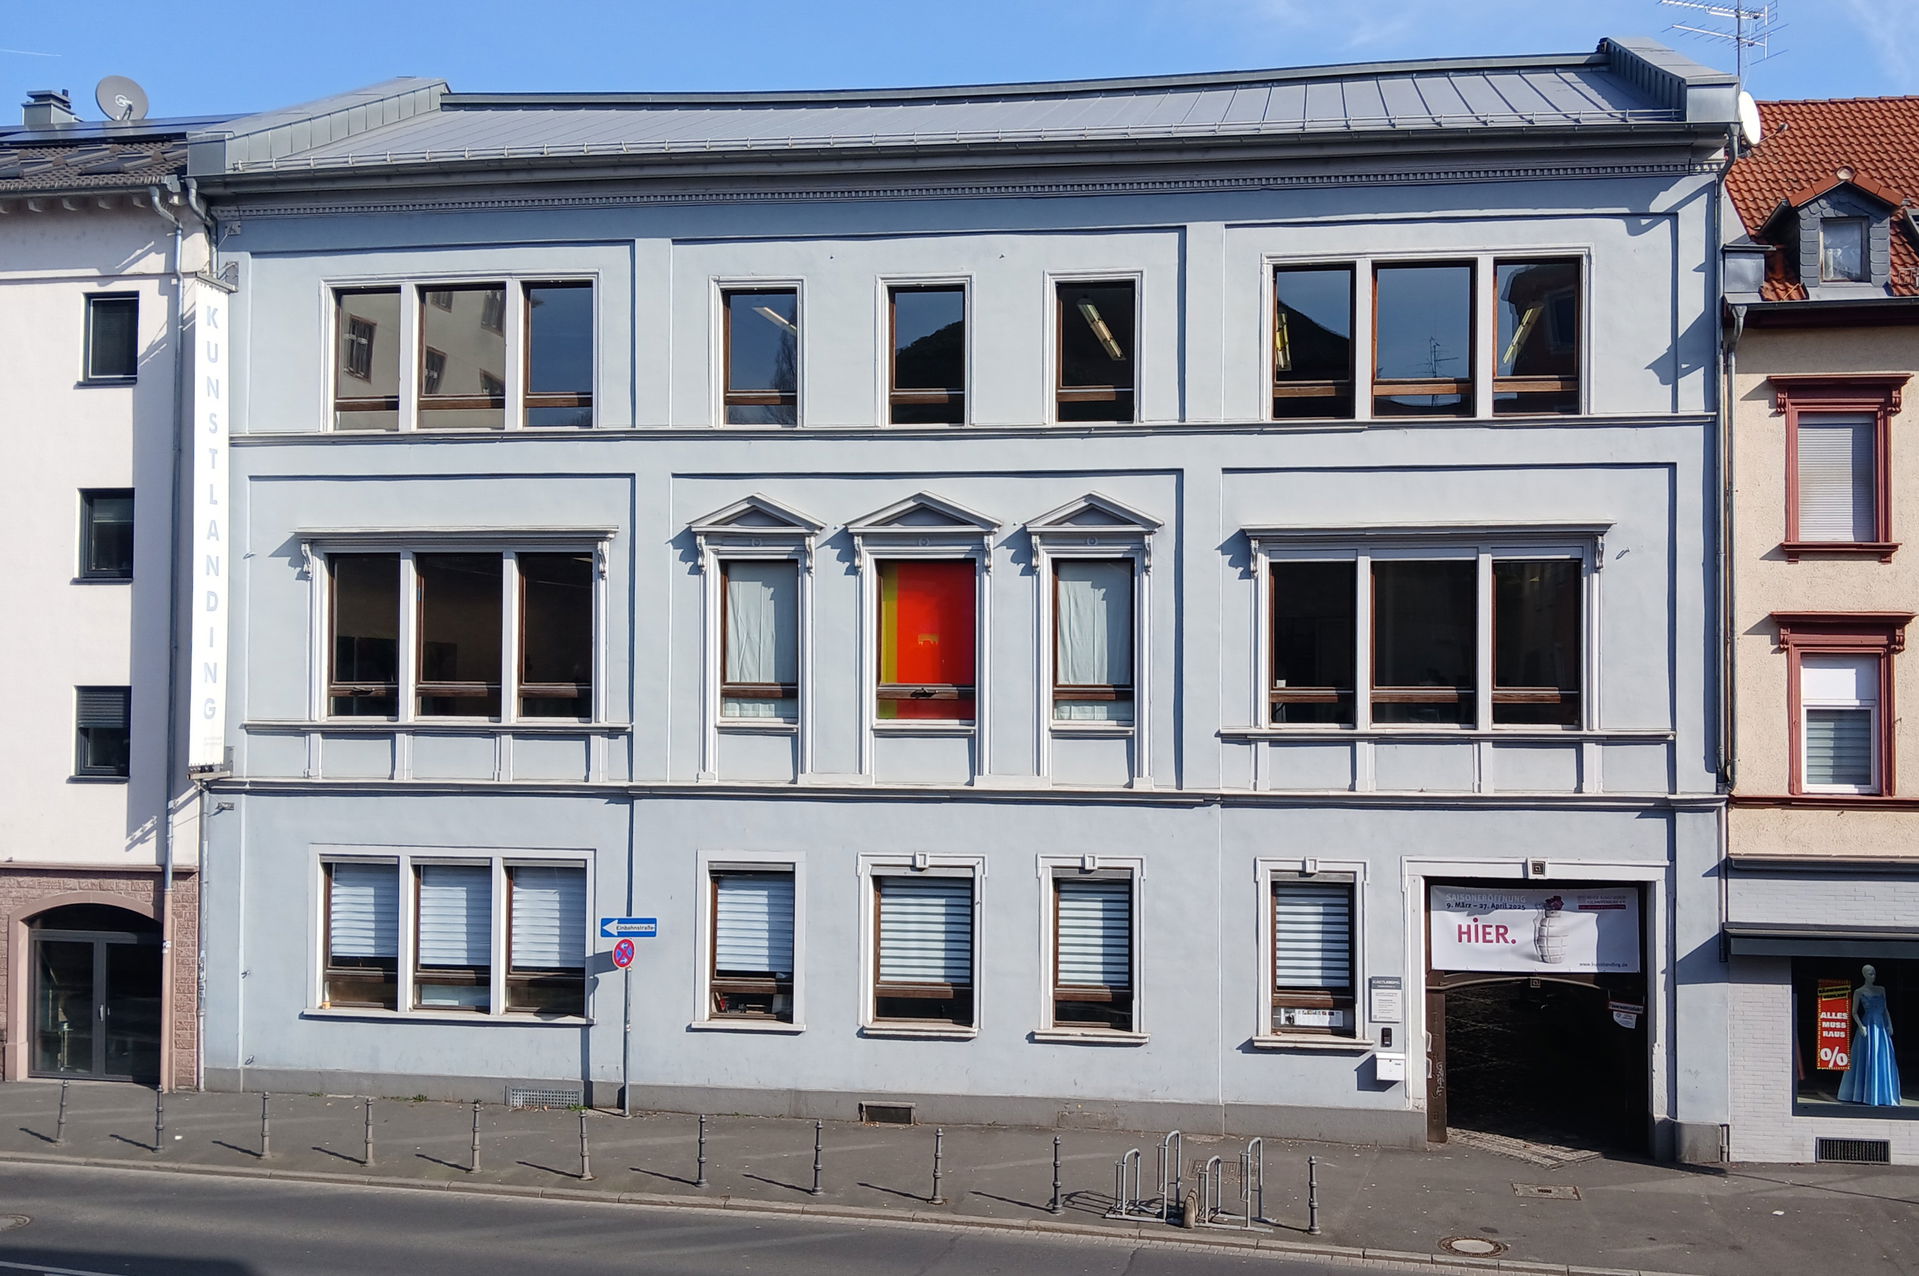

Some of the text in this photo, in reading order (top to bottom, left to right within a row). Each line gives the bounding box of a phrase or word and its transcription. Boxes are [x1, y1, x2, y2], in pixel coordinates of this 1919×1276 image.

[203, 305, 220, 721] KUNSTLANDING
[1491, 902, 1507, 911] April
[1820, 1012, 1848, 1020] ALLES
[1822, 1021, 1847, 1029] MUSS
[1823, 1030, 1846, 1038] RAUS
[1820, 1046, 1848, 1068] %
